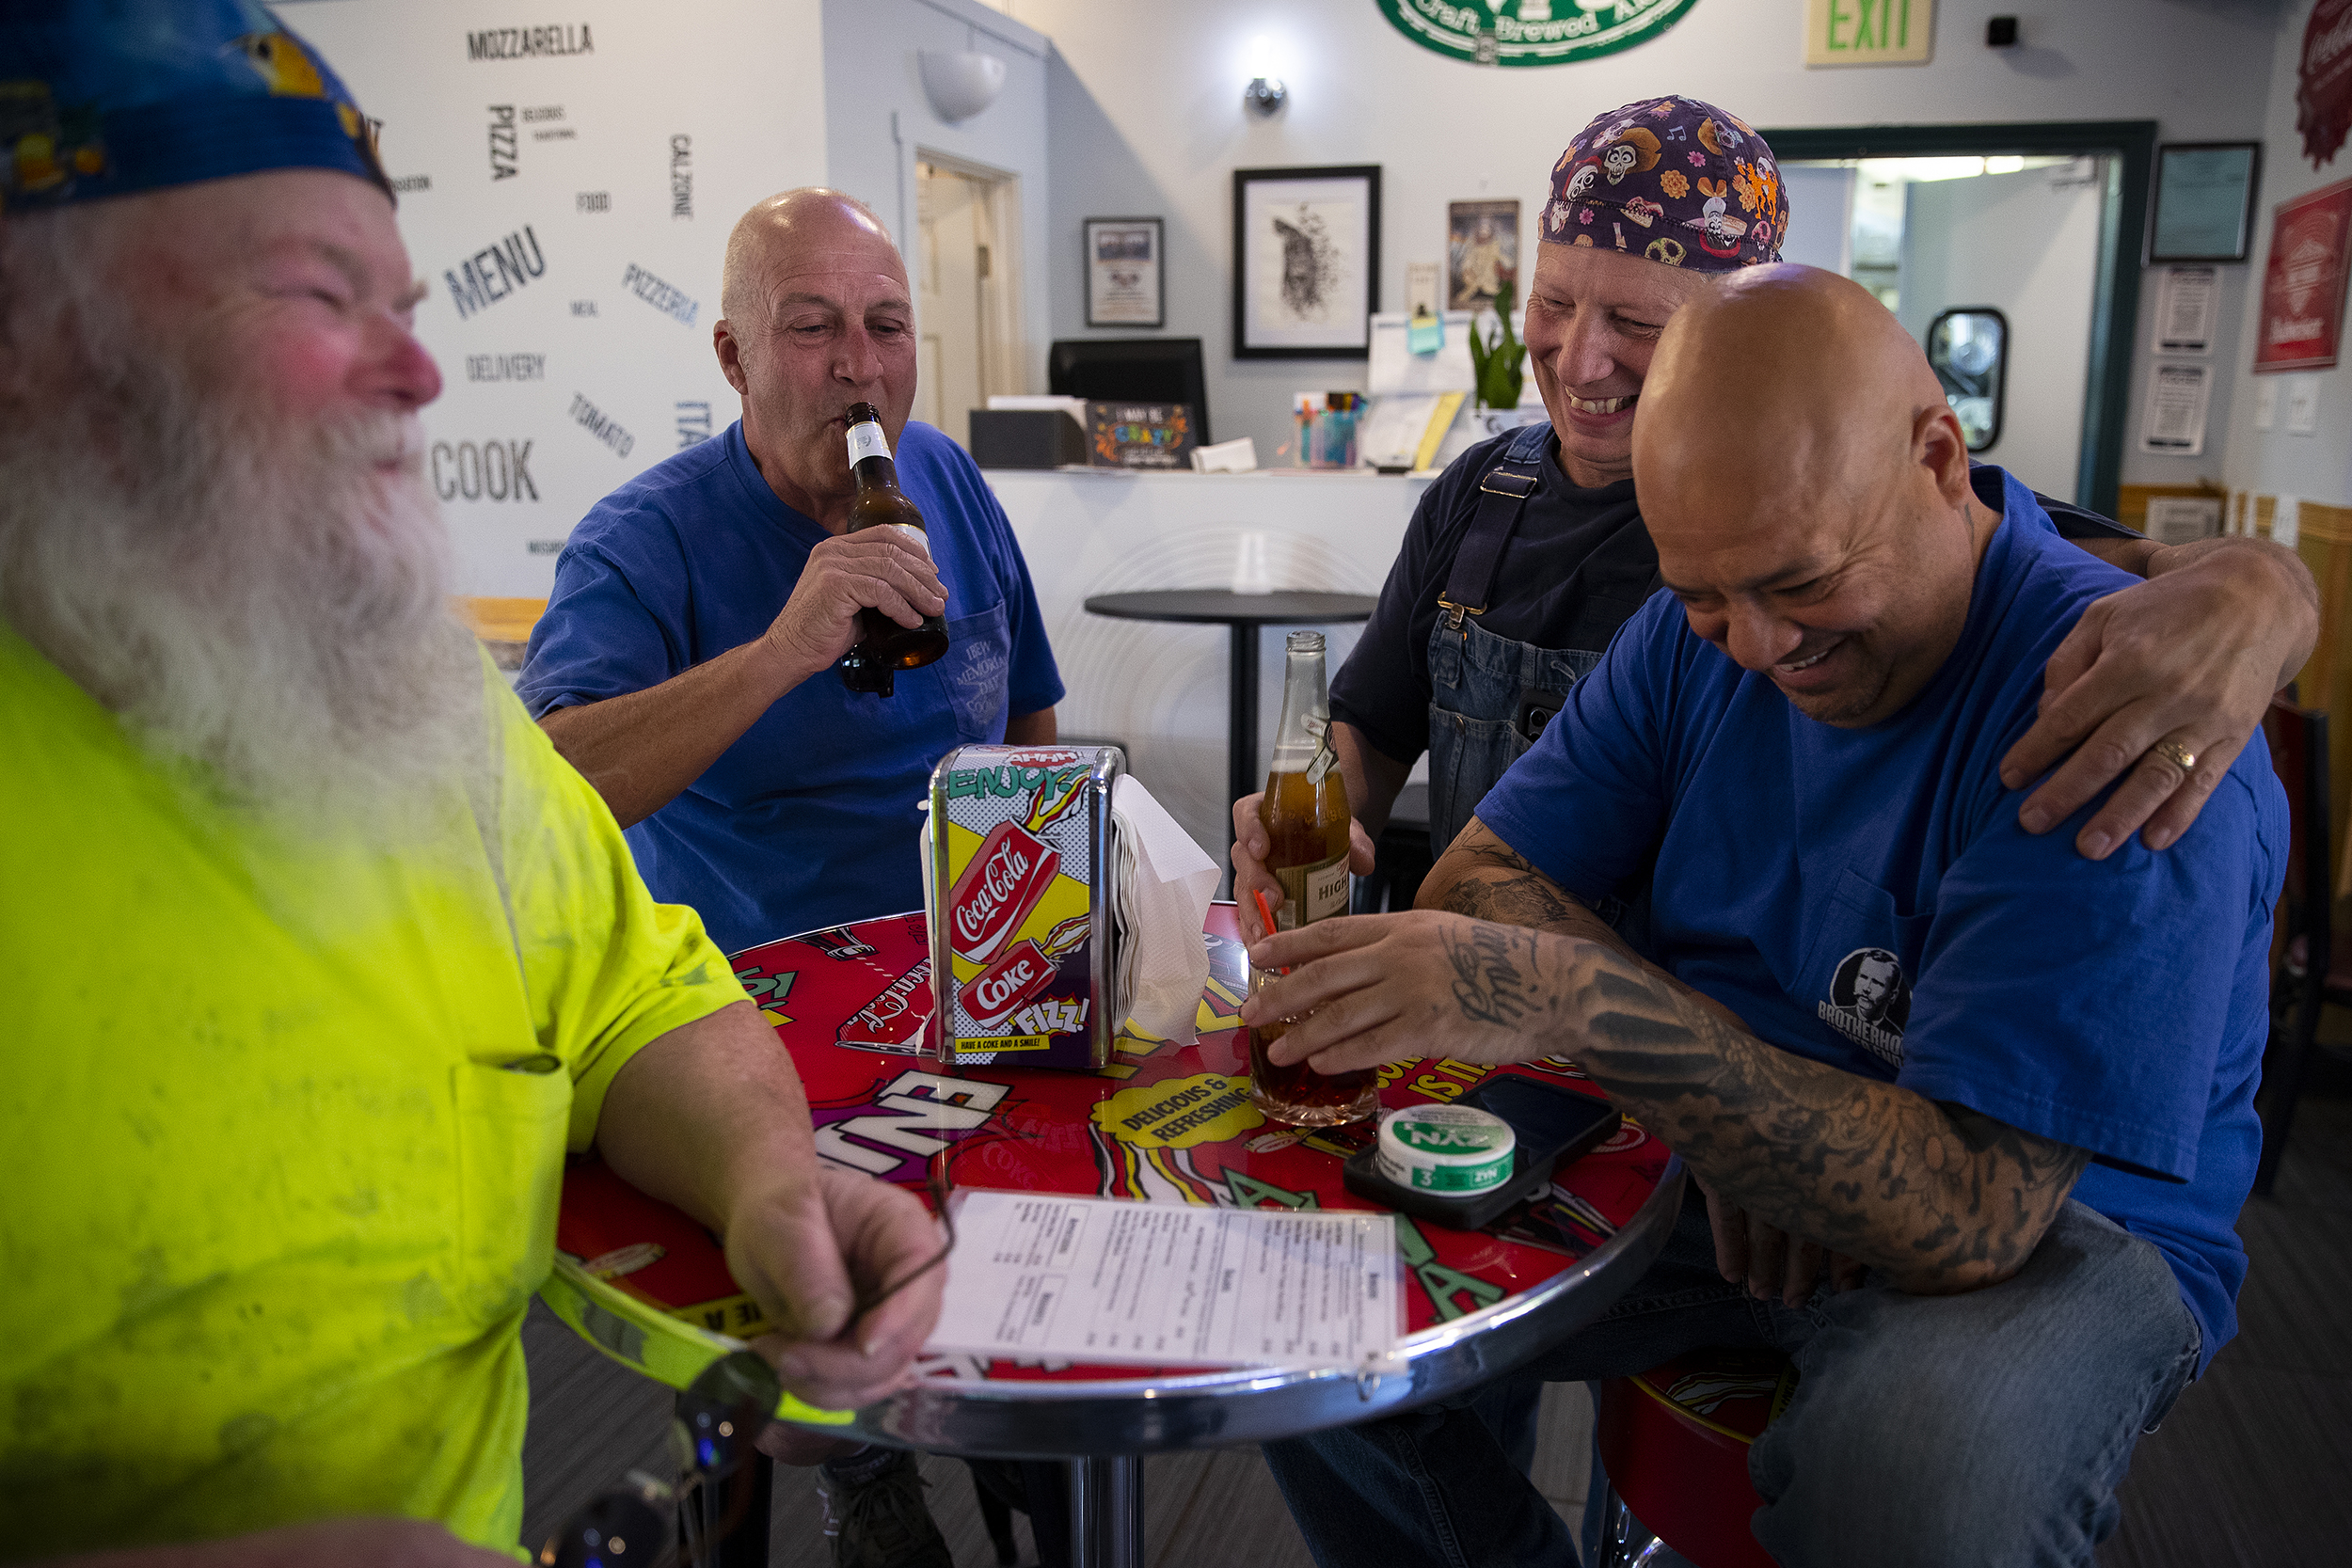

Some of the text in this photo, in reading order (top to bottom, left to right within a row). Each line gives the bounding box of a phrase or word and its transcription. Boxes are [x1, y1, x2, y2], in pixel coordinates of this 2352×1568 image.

[468, 23, 595, 62] MOZZARELLA
[1828, 0, 1910, 51] EXIT
[486, 103, 519, 182] PIZZA
[669, 133, 694, 221] CALZONE
[444, 224, 546, 321] MENU
[621, 261, 700, 328] PIZZERIA
[466, 353, 546, 382] DELIVERY
[568, 391, 635, 459] TOMATO
[675, 400, 712, 450] ITA
[431, 438, 540, 503] COOK
[947, 765, 1091, 801] ENJOY!
[956, 836, 1029, 942] Coca-Cola
[976, 959, 1034, 1010] Coke
[961, 1041, 976, 1050] HAVE
[982, 1039, 998, 1049] COKE
[1000, 1039, 1012, 1048] AND
[1020, 1037, 1041, 1047] SMILE!
[1014, 997, 1090, 1036] FIZZ!
[1818, 1000, 1904, 1058] BROTHERHO
[1121, 1078, 1228, 1132] DELICIOUS &
[1151, 1086, 1251, 1144] REFRESHING
[1420, 1167, 1433, 1187] 3
